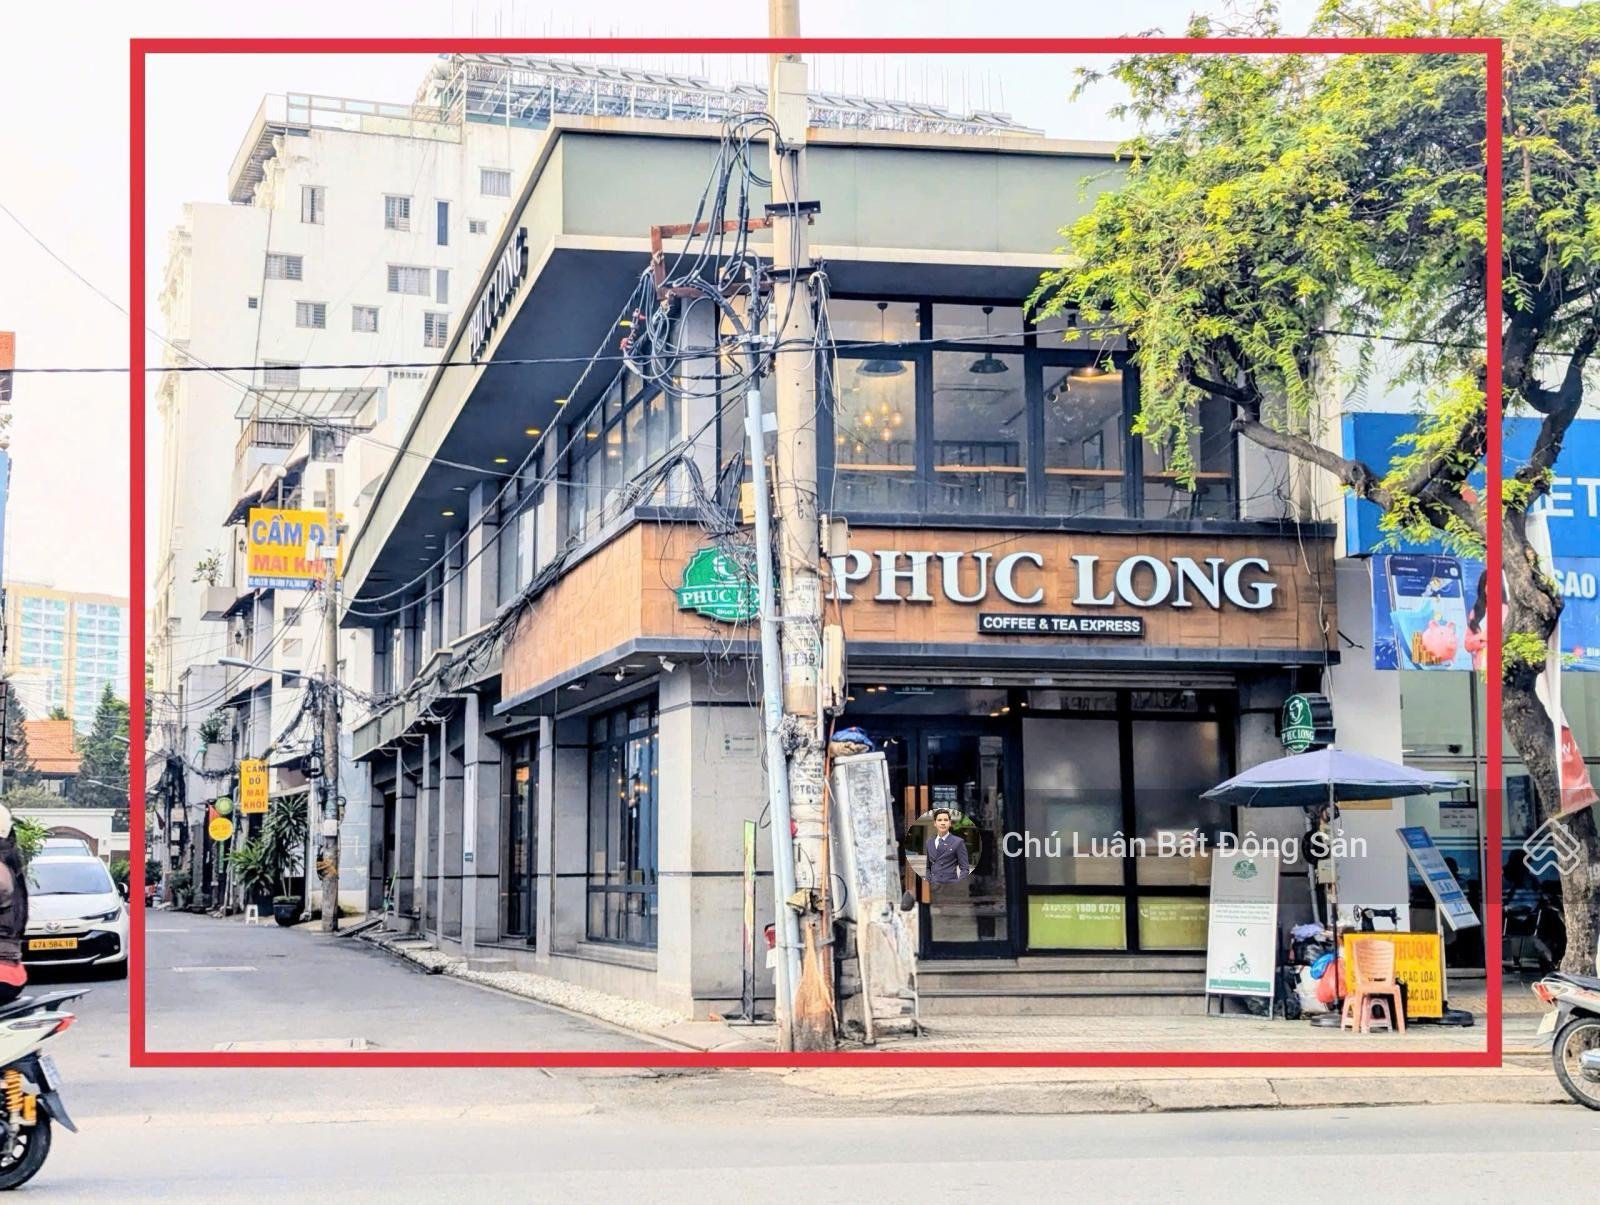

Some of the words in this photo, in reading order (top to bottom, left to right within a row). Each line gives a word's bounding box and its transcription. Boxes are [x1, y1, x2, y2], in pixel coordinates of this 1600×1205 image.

[468, 283, 499, 366] PHUC
[494, 227, 529, 318] LONG
[681, 589, 733, 605] PHUC
[825, 549, 1045, 604] PHUC
[1071, 554, 1278, 610] LONG
[982, 616, 1036, 631] COFFEE
[1039, 617, 1049, 631] &
[1051, 618, 1078, 632] TEA
[1080, 619, 1141, 633] EXPRESS
